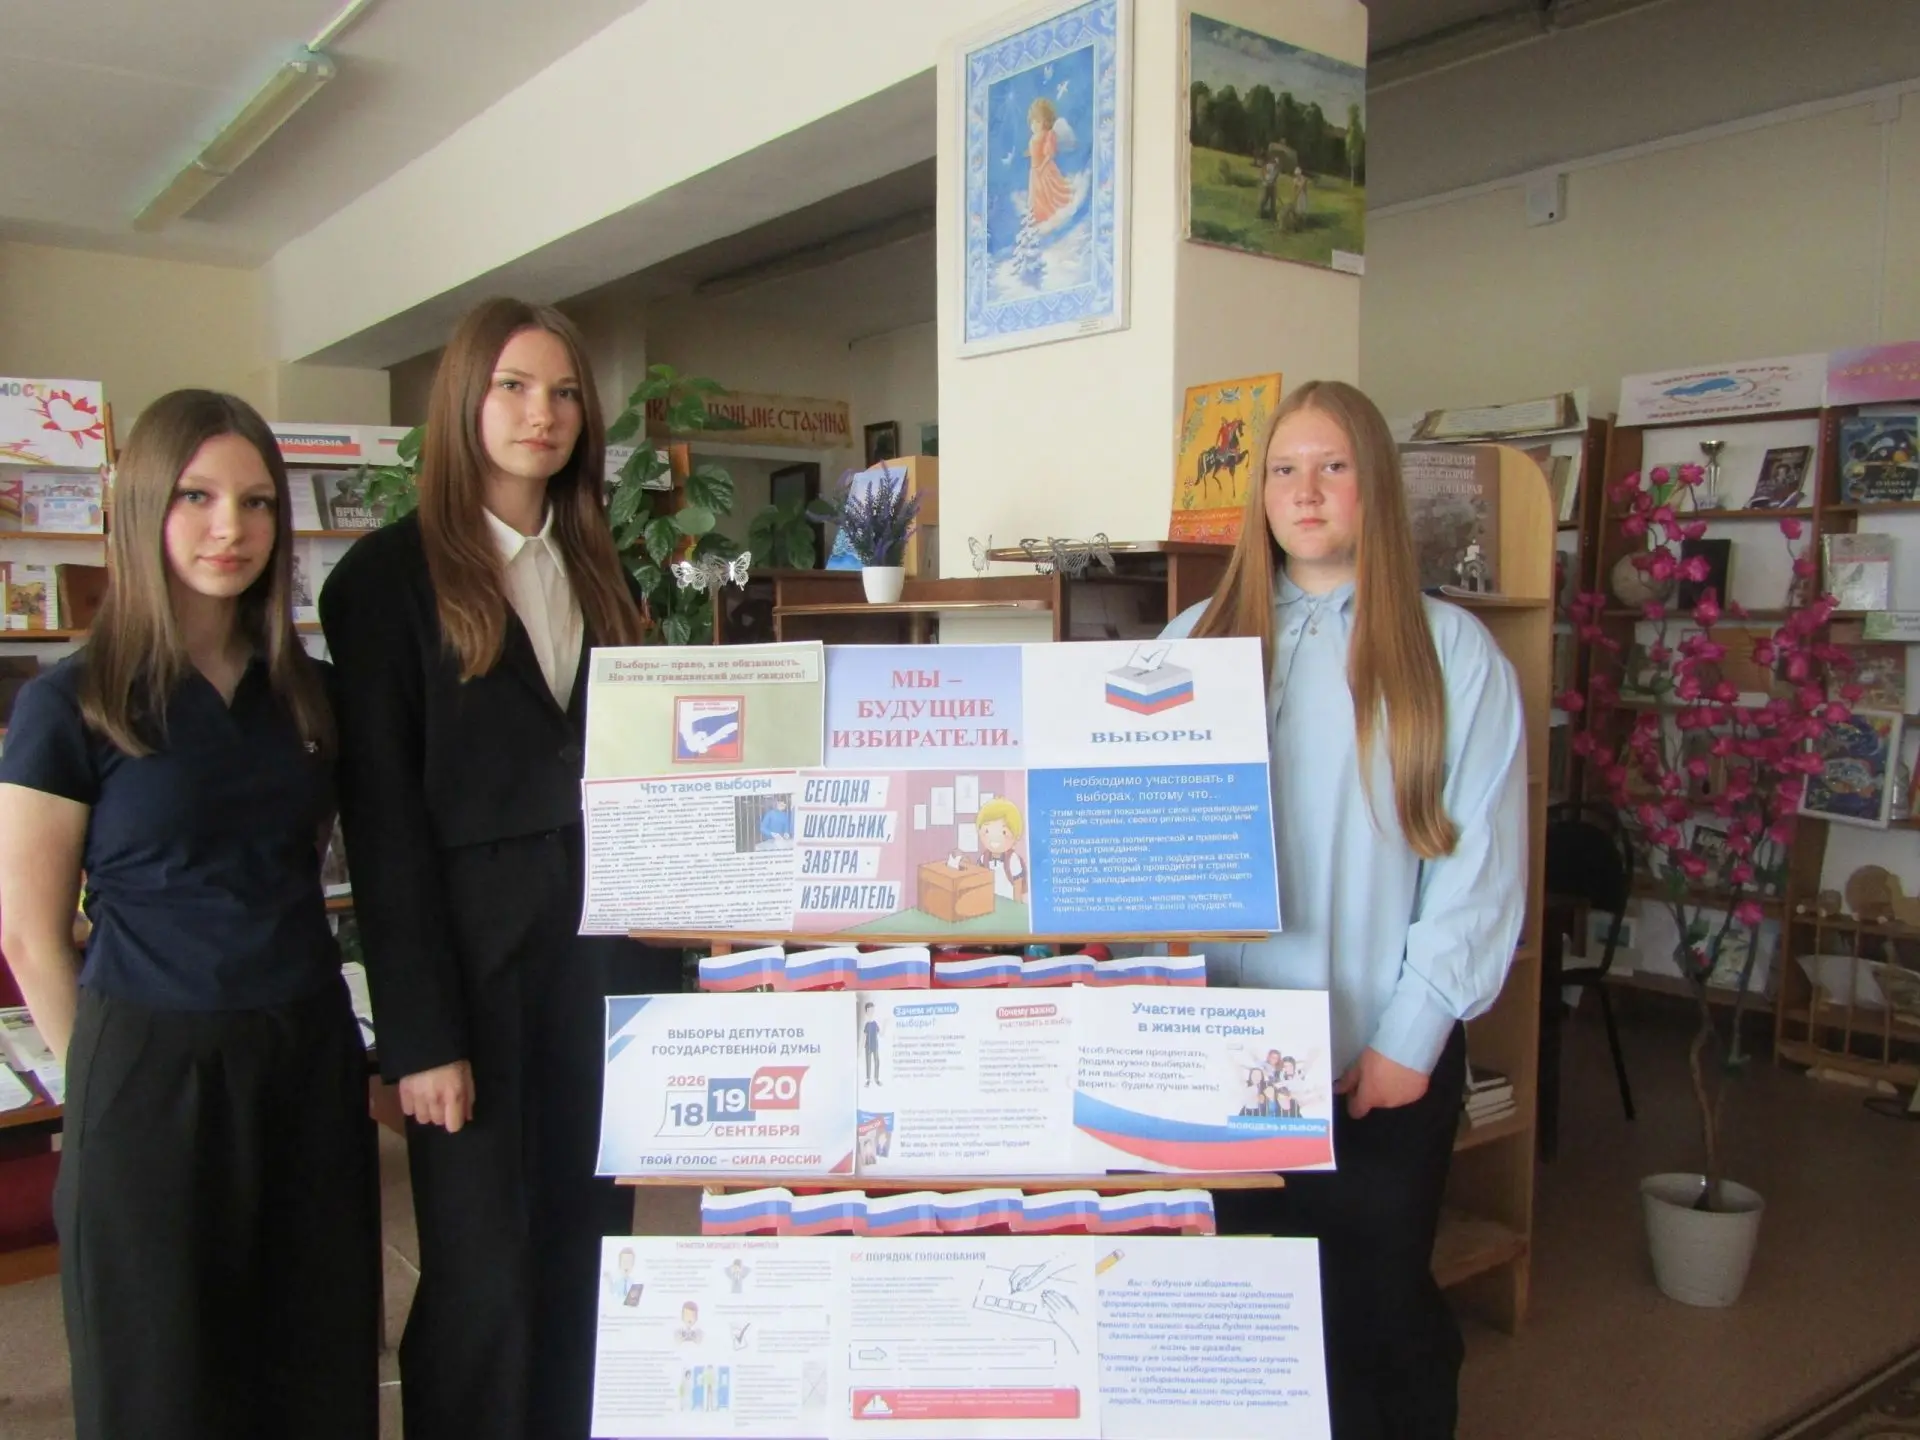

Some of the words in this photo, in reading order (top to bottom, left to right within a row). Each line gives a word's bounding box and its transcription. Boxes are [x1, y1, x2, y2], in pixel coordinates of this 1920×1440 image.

[890, 669, 940, 688] МЫ
[857, 698, 995, 721] БУДУЩИЕ
[831, 727, 1019, 749] ИЗБИРАТЕЛИ.
[1091, 729, 1213, 743] ВЫБОРЫ
[640, 783, 667, 794] Что
[672, 782, 711, 793] такое
[715, 777, 772, 792] выборы
[1063, 775, 1142, 788] Необходимо
[1146, 774, 1224, 787] участвовать
[1227, 775, 1234, 783] в
[804, 779, 871, 806] СЕГОДНЯ
[1076, 791, 1135, 804] выборах,
[1138, 790, 1184, 803] потому
[802, 813, 892, 843] ШКОЛЬНИК,
[801, 849, 859, 874] ЗАВТРА
[799, 881, 897, 910] ИЗБИРАТЕЛЬ
[895, 1006, 925, 1016] Зачем
[925, 1005, 958, 1015] нужны
[998, 1007, 1029, 1018] Почему
[1030, 1005, 1055, 1015] важно
[1132, 1001, 1196, 1017] Участие
[1200, 1004, 1266, 1019] граждан
[667, 1029, 725, 1039] ВЫБОРЫ
[728, 1027, 805, 1040] ДЕПУТАТОВ
[1137, 1022, 1147, 1032] в
[1152, 1022, 1201, 1034] жизни
[1204, 1022, 1265, 1037] страны
[651, 1043, 777, 1057] ГОСУДАРСТВЕННОЙ
[779, 1043, 821, 1056] ДУМЫ
[667, 1075, 706, 1087] 2026
[754, 1076, 797, 1100] 20
[712, 1088, 746, 1113] 19
[670, 1102, 704, 1127] 18
[714, 1124, 800, 1137] СЕНТЯБРЯ
[639, 1154, 672, 1165] ТВОЙ
[675, 1155, 717, 1165] ГОЛОС
[731, 1155, 766, 1165] СИЛА
[770, 1154, 822, 1165] РОССИИ
[866, 1251, 913, 1263] ПОРЯДОК
[914, 1251, 986, 1261] ГОЛОСОВАНИЯ
